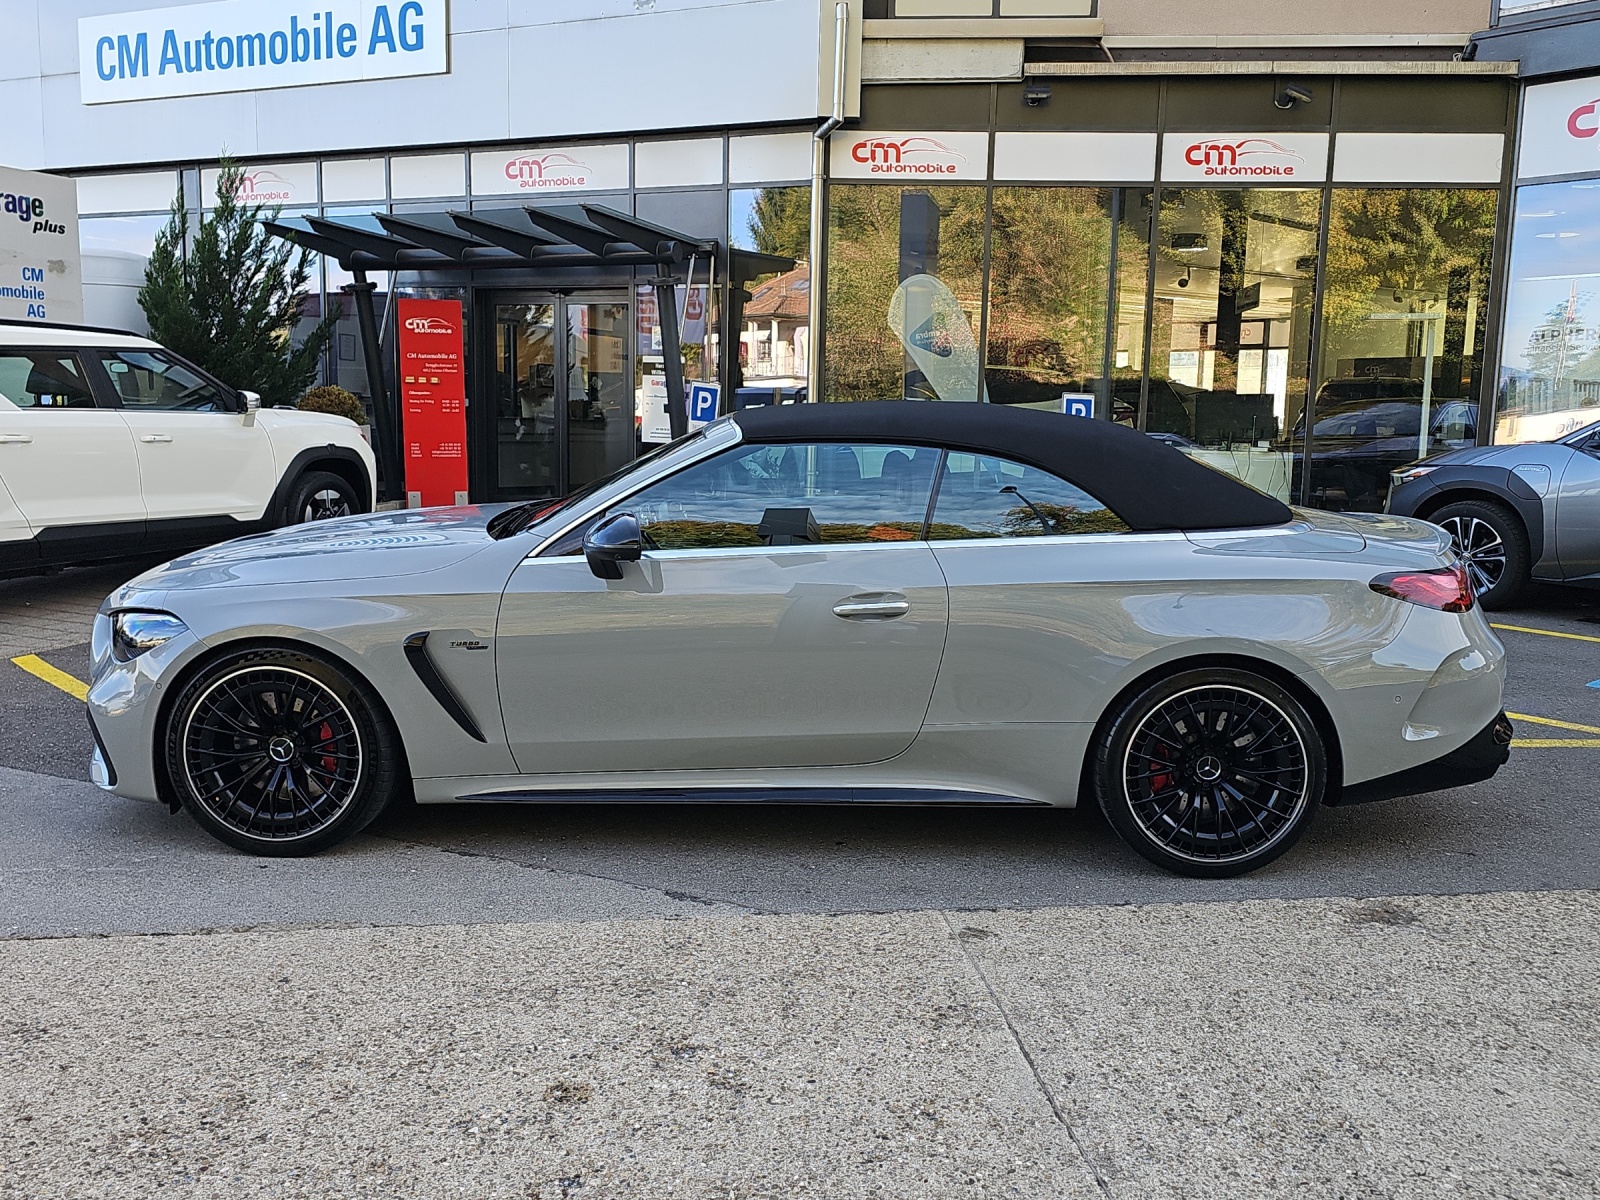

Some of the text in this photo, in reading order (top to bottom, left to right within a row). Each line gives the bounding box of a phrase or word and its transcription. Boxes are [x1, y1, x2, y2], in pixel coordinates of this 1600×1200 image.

[96, 1, 424, 81] CM Automobile AG
[852, 142, 901, 163] cm
[1185, 145, 1237, 166] cm
[505, 160, 543, 179] cm
[871, 163, 957, 174] automobile
[1204, 165, 1295, 176] automobile
[520, 176, 586, 188] automobile
[235, 191, 290, 202] automobile
[0, 193, 45, 222] age
[33, 219, 66, 235] plus
[22, 267, 45, 282] CM
[0, 285, 45, 300] mobile
[27, 303, 46, 318] AG
[697, 390, 712, 417] P
